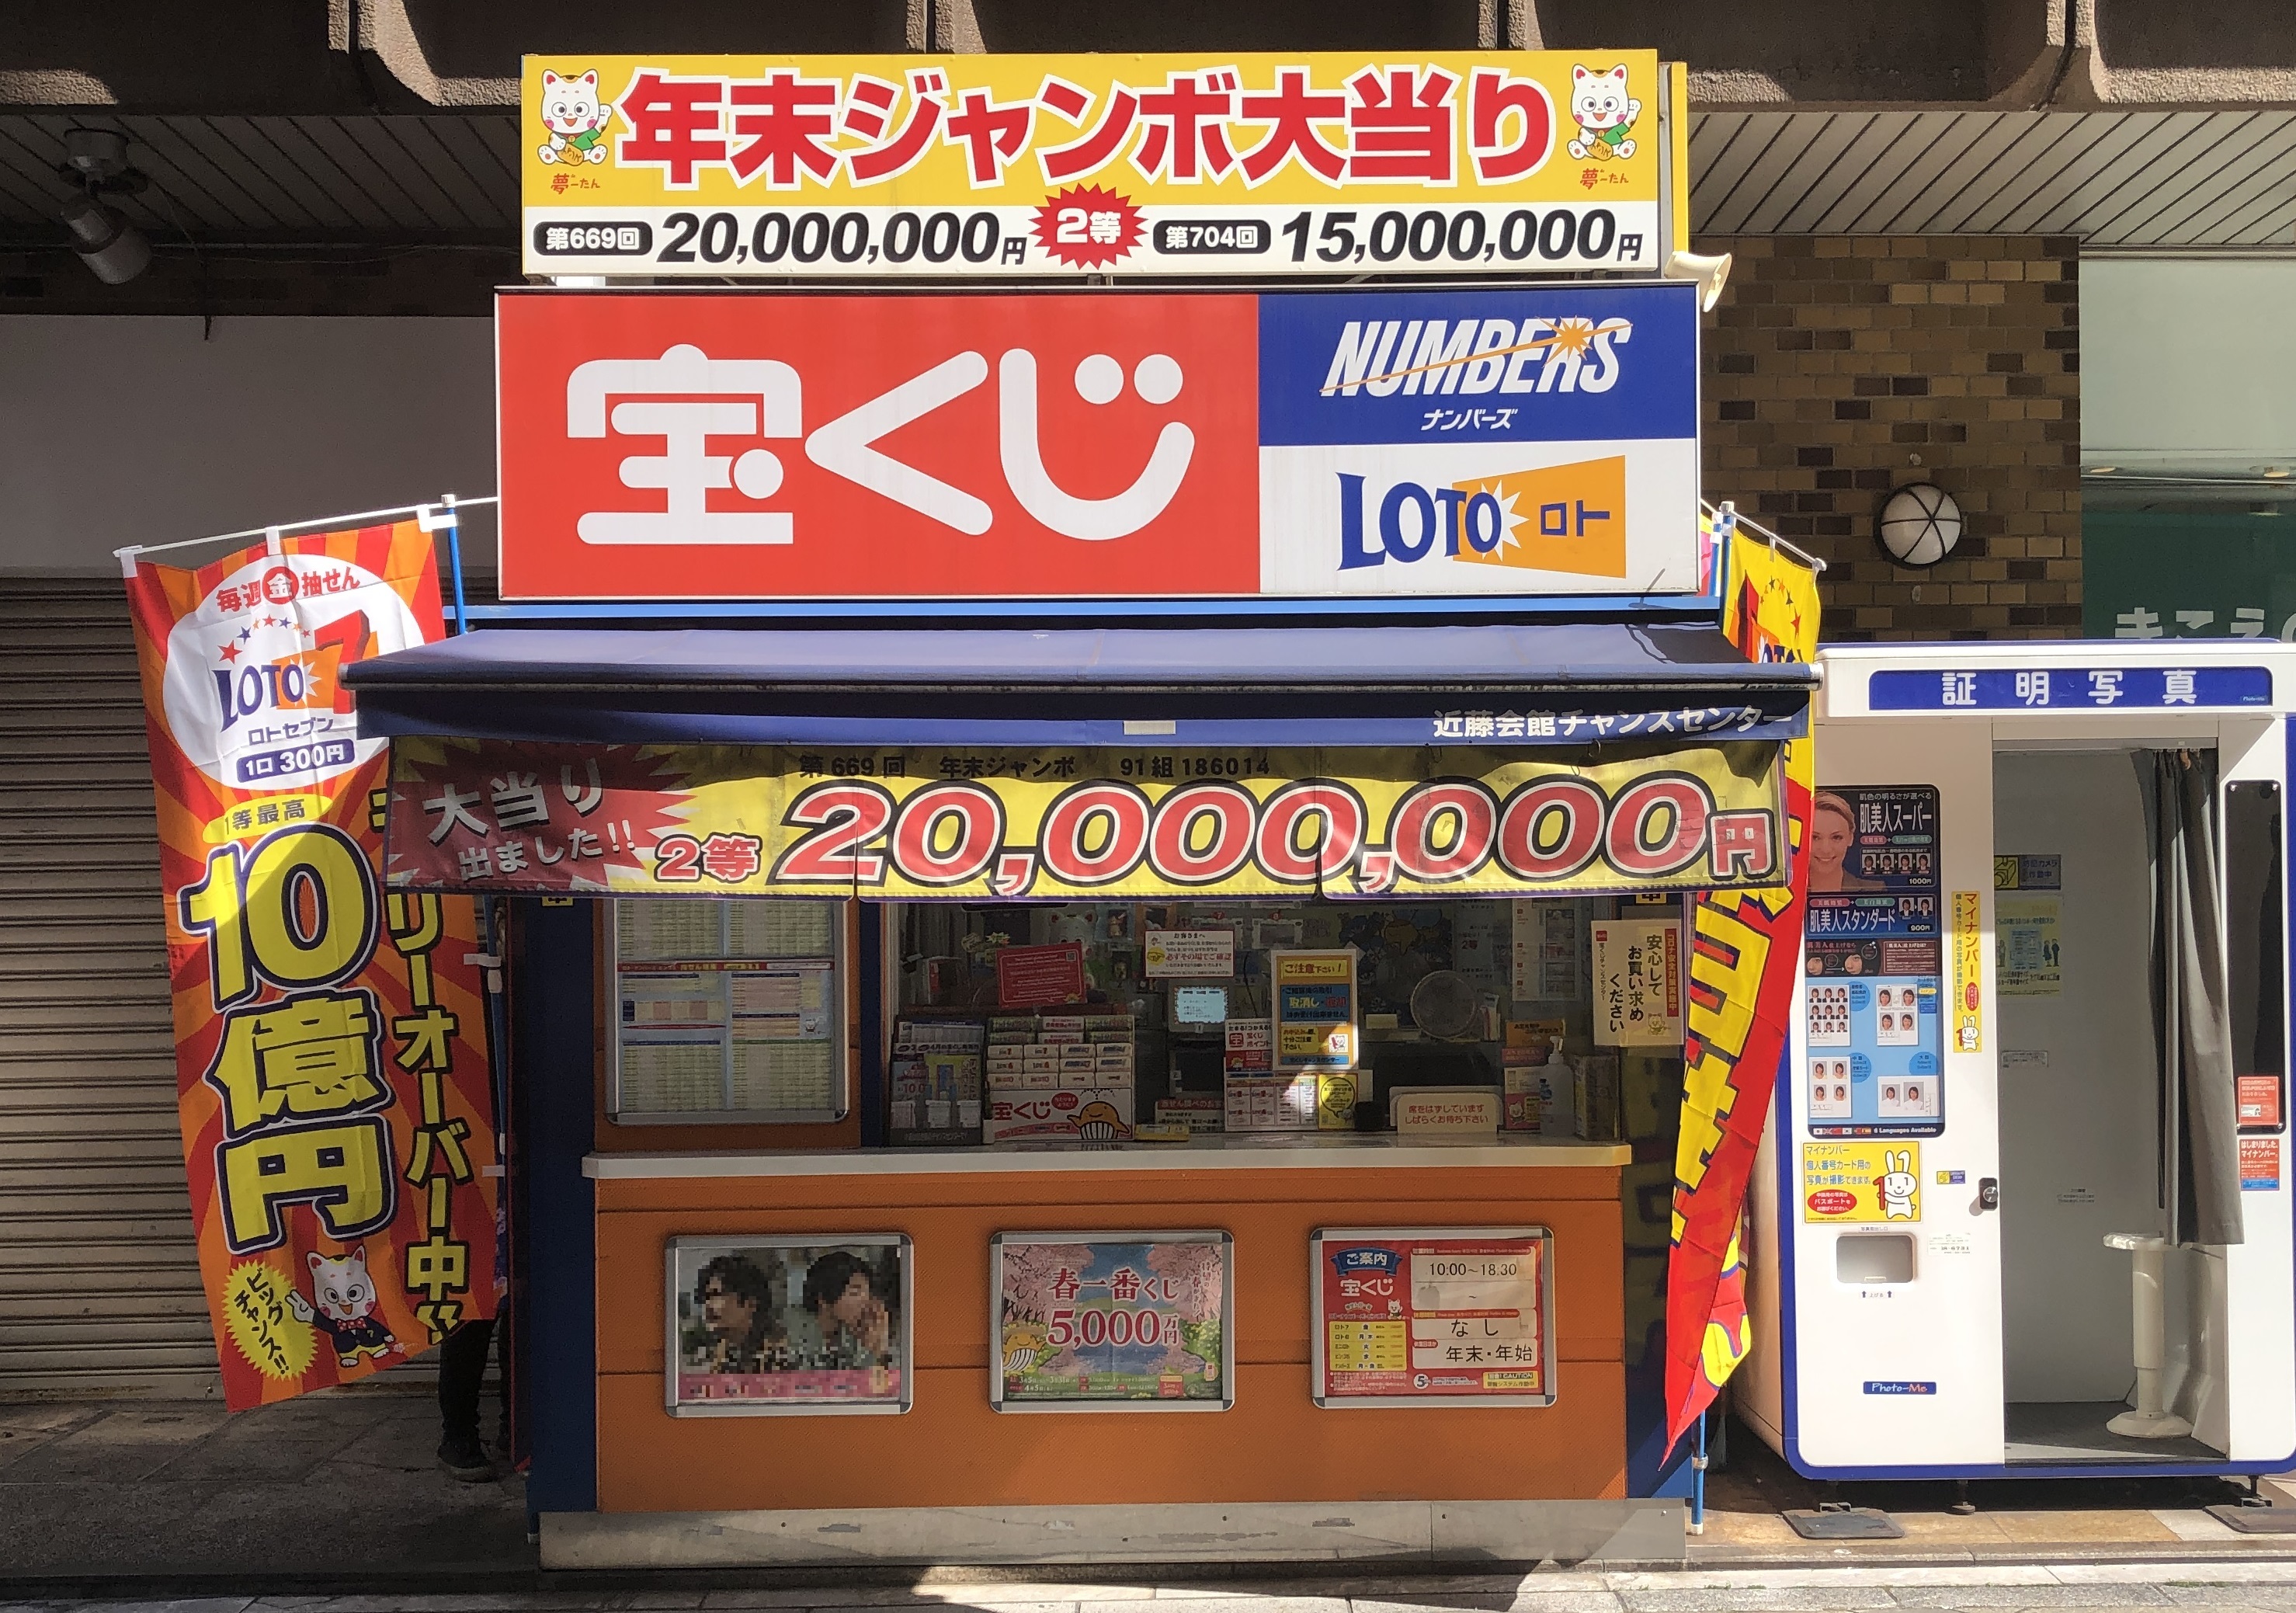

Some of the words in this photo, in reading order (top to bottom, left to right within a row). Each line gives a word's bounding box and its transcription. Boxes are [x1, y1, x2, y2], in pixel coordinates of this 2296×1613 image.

[616, 67, 1554, 188] 年末ジャンボ大当り
[545, 226, 640, 250] 第669回
[657, 211, 1027, 266] 20,000,000円
[1056, 208, 1123, 244] 2等
[1165, 226, 1258, 249] 第704回
[1281, 209, 1642, 262] 15,000,000円
[1321, 317, 1633, 397] NUMBERS
[1420, 408, 1518, 430] ナンバーズ
[567, 343, 1196, 541] 宝くじ
[1335, 471, 1502, 571] LOTO
[212, 665, 305, 733] LOTO
[1941, 669, 2197, 706] 証明写真
[248, 717, 334, 746] ロトセブン
[1433, 709, 1793, 739] 近藤会館チャンスセンター
[280, 743, 344, 771] 300円
[939, 756, 1075, 777] 年末ジャンボ
[422, 757, 603, 845] 大当り
[1859, 792, 1932, 801] 肌色の明るさが選べる
[224, 798, 306, 836] 1等最高
[1859, 801, 1933, 834] 肌美人スーパー
[458, 819, 637, 881] 出ました!!
[770, 774, 1772, 895] 20,000,000円
[656, 833, 760, 882] 2等
[1810, 907, 1895, 933] 肌美人スタンダード
[1964, 893, 1979, 978] マイナンバー
[1646, 934, 1663, 996] 安心して
[1627, 945, 1645, 1022] お買い求め
[1609, 972, 1625, 1033] ください
[186, 827, 392, 1247] 10億円
[992, 1101, 1051, 1121] 宝くじ
[1405, 1115, 1488, 1125] しばらくお待ち下さい
[1408, 1104, 1485, 1114] 席をはずしています
[1805, 1145, 1850, 1156] マイナンバー
[1806, 1159, 1871, 1171] 個人番号カード用の
[1806, 1175, 1871, 1186] 写真が撮影できます。
[1346, 1253, 1388, 1266] ご案内
[245, 1267, 283, 1326] ビッグ
[1048, 1267, 1179, 1300] 春一番くじ
[1340, 1278, 1394, 1297] 宝くじ
[1446, 1344, 1534, 1362] 年末・年始
[1871, 1382, 1928, 1392] Photo-Me
